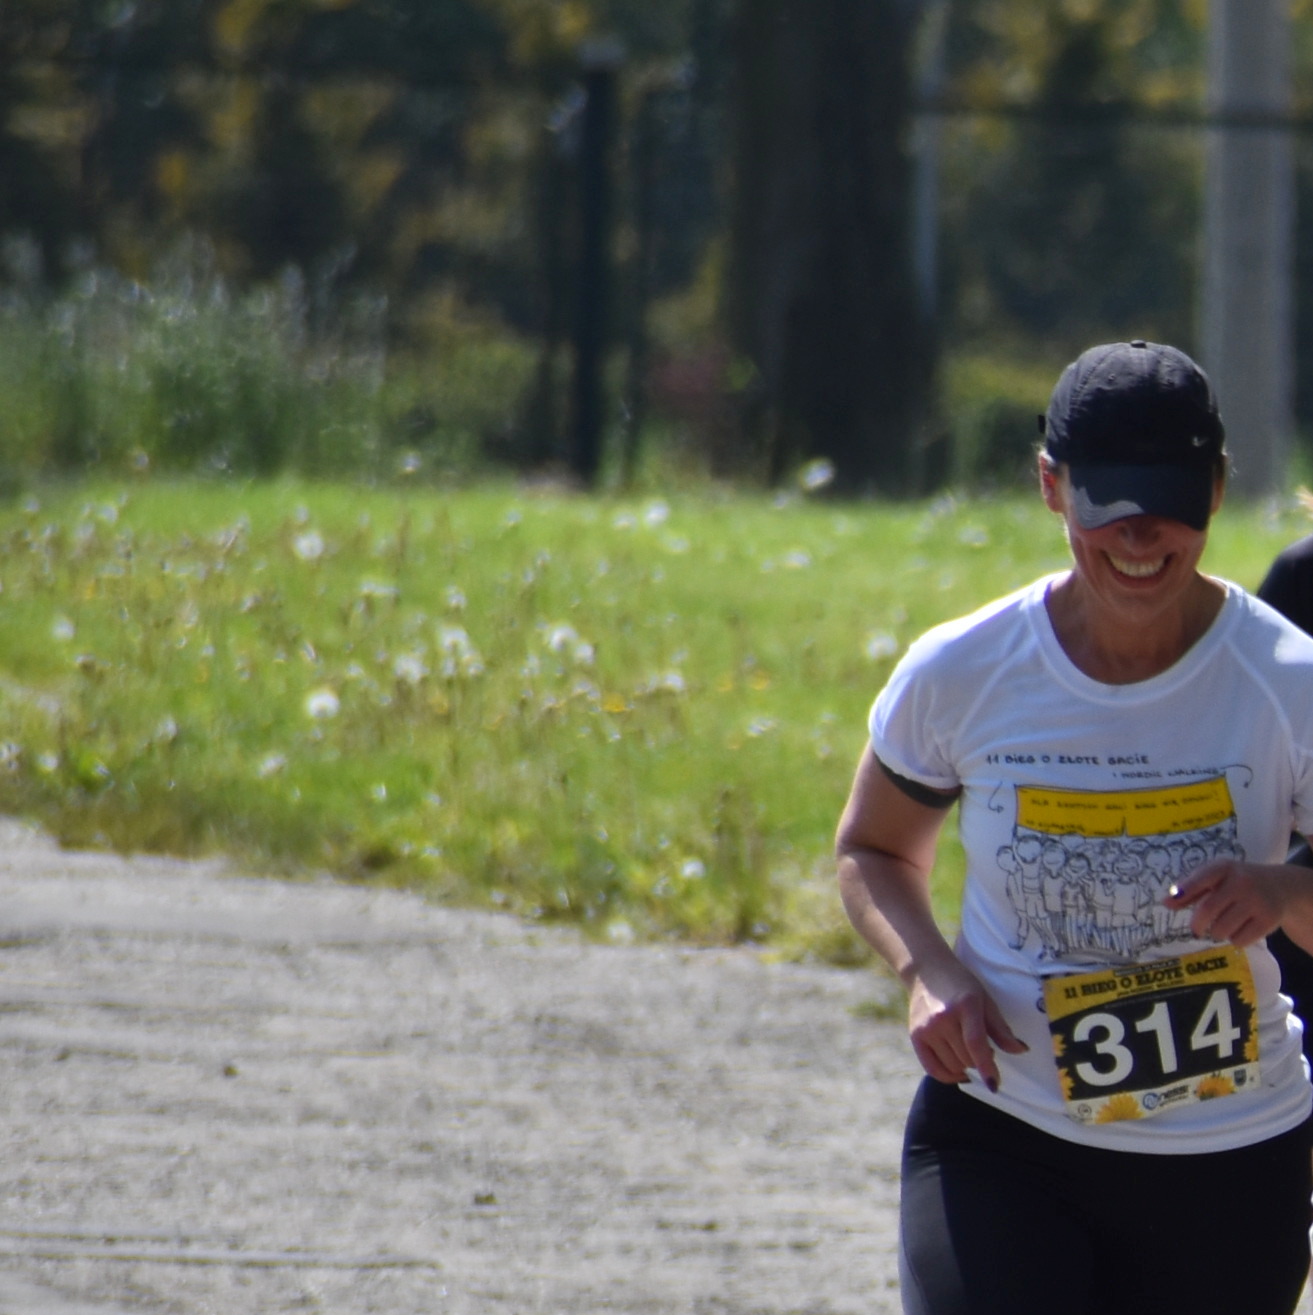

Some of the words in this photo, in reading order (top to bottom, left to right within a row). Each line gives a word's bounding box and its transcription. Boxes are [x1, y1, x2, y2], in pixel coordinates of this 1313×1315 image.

[986, 754, 1000, 766] 11
[1042, 755, 1051, 764] O
[1064, 987, 1079, 1000] 11
[1080, 978, 1118, 997] BIEG
[1121, 978, 1133, 990] O
[1186, 957, 1229, 975] GACIE
[1074, 988, 1241, 1087] 314
